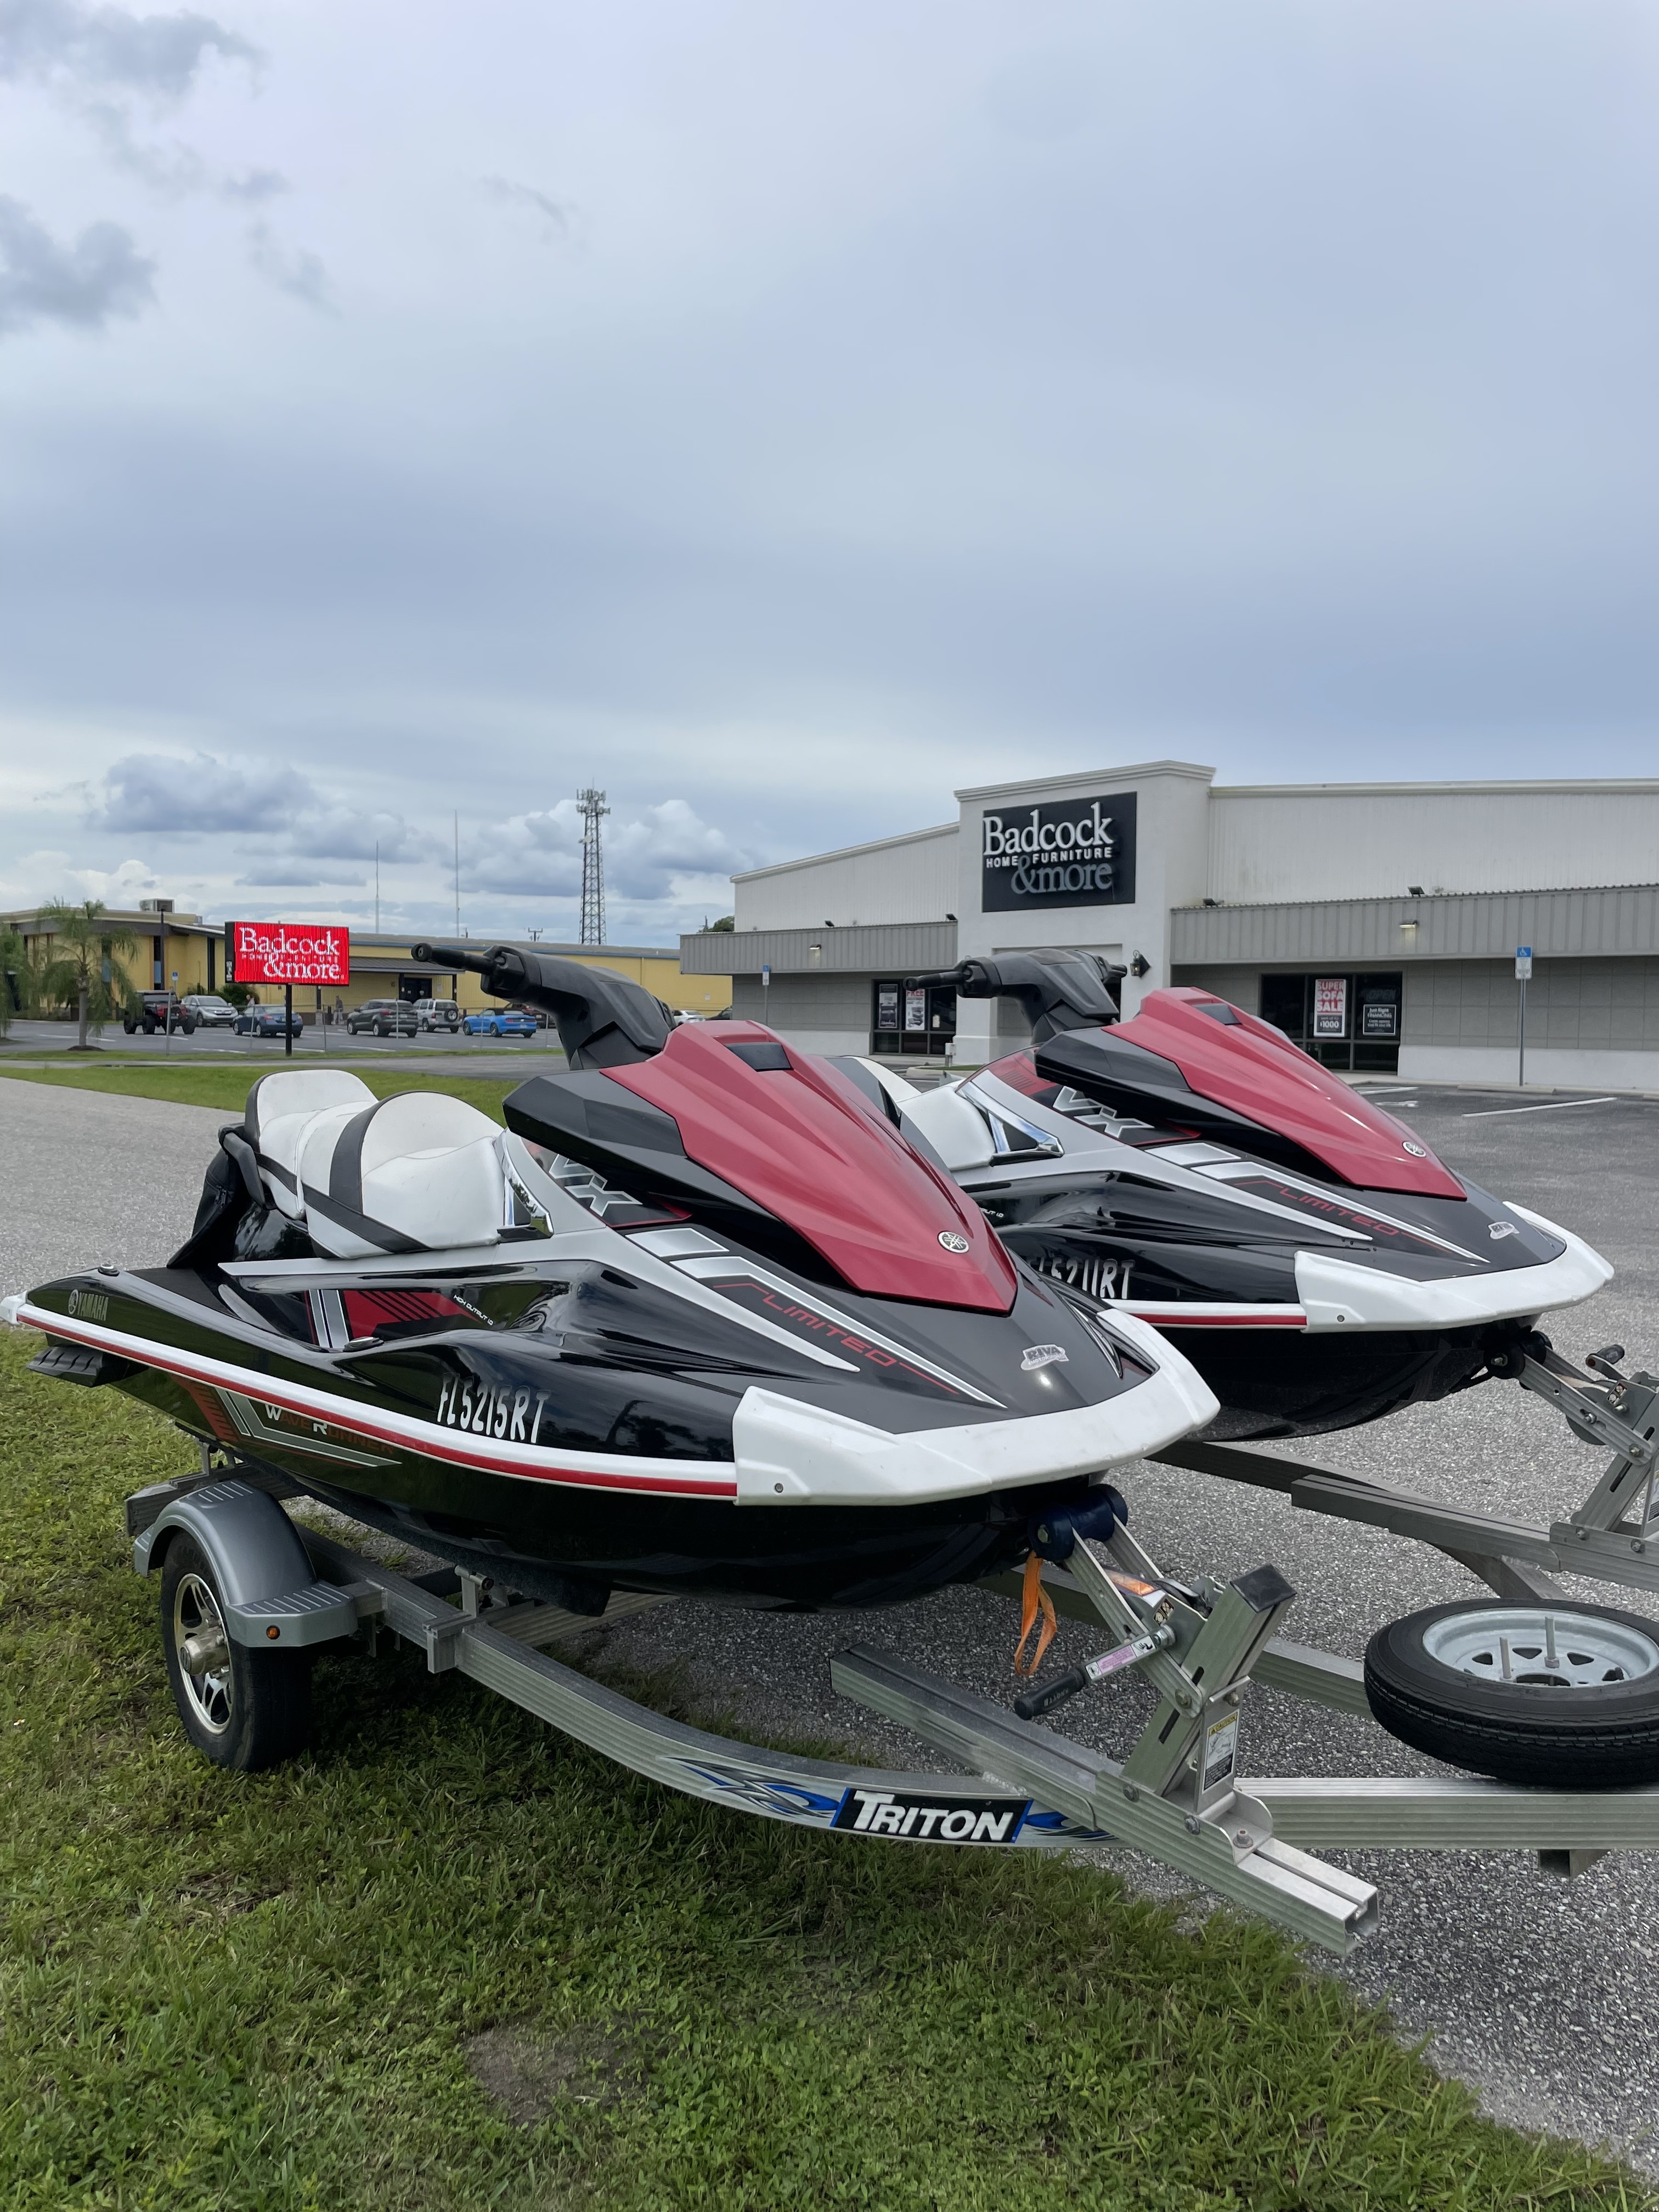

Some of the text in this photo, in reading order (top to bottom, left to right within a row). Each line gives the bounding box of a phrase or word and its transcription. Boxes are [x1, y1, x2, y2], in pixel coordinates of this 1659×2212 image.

[982, 802, 1114, 855] Badcock
[986, 847, 1113, 868] HOME FURNITURE
[1011, 855, 1112, 894] &more
[239, 927, 340, 955] Badcock
[264, 952, 340, 979] &more
[1317, 981, 1344, 990] SUPER
[1317, 990, 1344, 1000] SOFA
[1317, 1001, 1343, 1011] SALE
[1320, 1020, 1339, 1029] $1000
[1053, 1086, 1154, 1138] VX
[1279, 1188, 1400, 1235] LIMITED
[77, 1292, 109, 1321] YAMAHA
[466, 1303, 488, 1320] OUTPUT
[763, 1294, 896, 1367] LIMITED
[1025, 1346, 1062, 1360] RIVA
[1216, 1714, 1236, 1730] CAUTION
[853, 1790, 1014, 1841] TRITON
